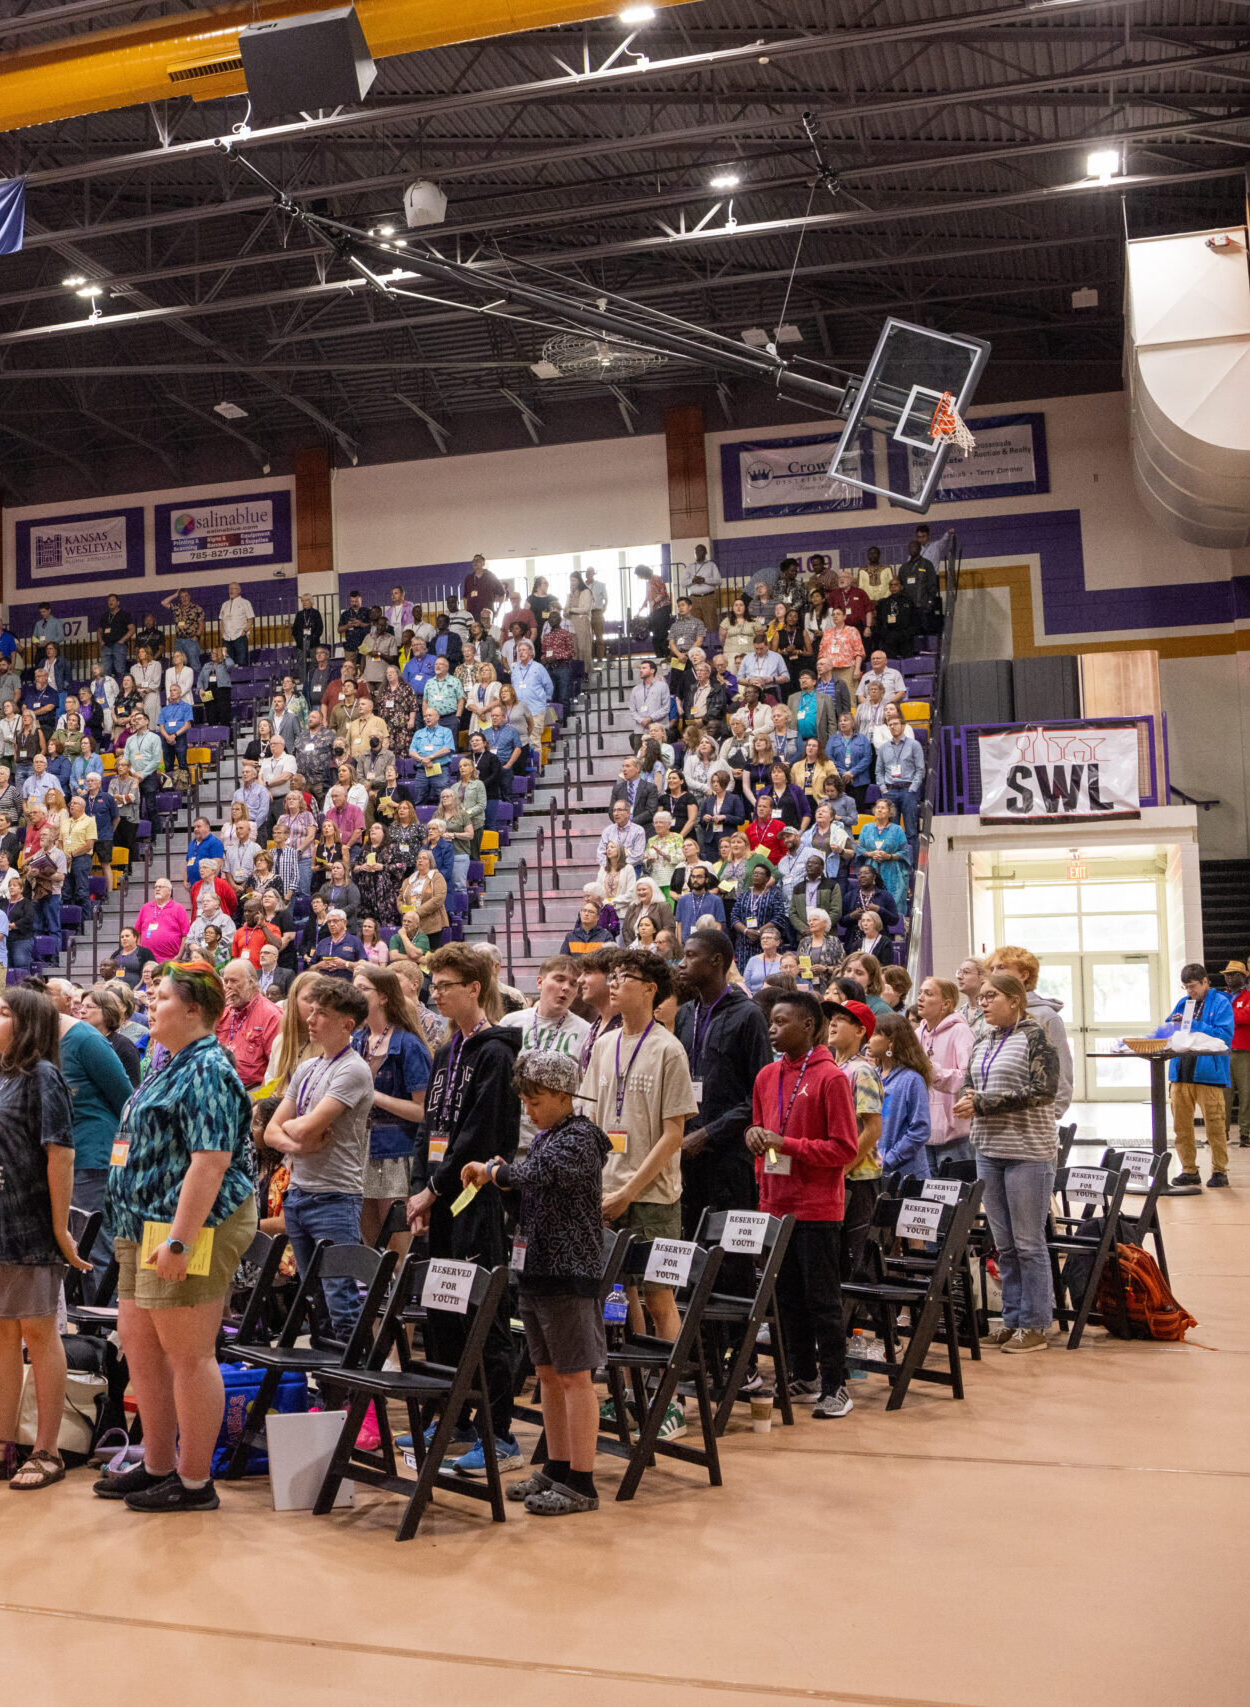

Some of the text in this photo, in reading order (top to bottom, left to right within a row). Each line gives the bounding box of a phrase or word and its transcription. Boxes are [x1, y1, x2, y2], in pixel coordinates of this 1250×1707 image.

[788, 461, 831, 473] Crow
[196, 506, 268, 529] salinablue
[65, 531, 108, 545] KANSAS
[65, 541, 122, 556] WESLEYAN
[190, 547, 254, 560] 785-827-6182
[63, 620, 82, 637] 07
[1006, 763, 1114, 814] SWL
[1069, 866, 1087, 879] EXIT
[524, 1028, 578, 1056] CIFIC
[1071, 1172, 1104, 1180] RESERVED
[904, 1204, 939, 1214] RESERVED
[729, 1216, 765, 1224] RESERVED
[906, 1227, 930, 1235] YOUTH
[731, 1239, 755, 1247] YOUTH
[655, 1244, 691, 1255] RESERVED
[663, 1258, 678, 1267] FOR
[431, 1265, 472, 1277] RESERVED
[656, 1270, 680, 1280] YOUTH
[441, 1281, 457, 1290] FOR
[432, 1293, 460, 1305] YOUTH
